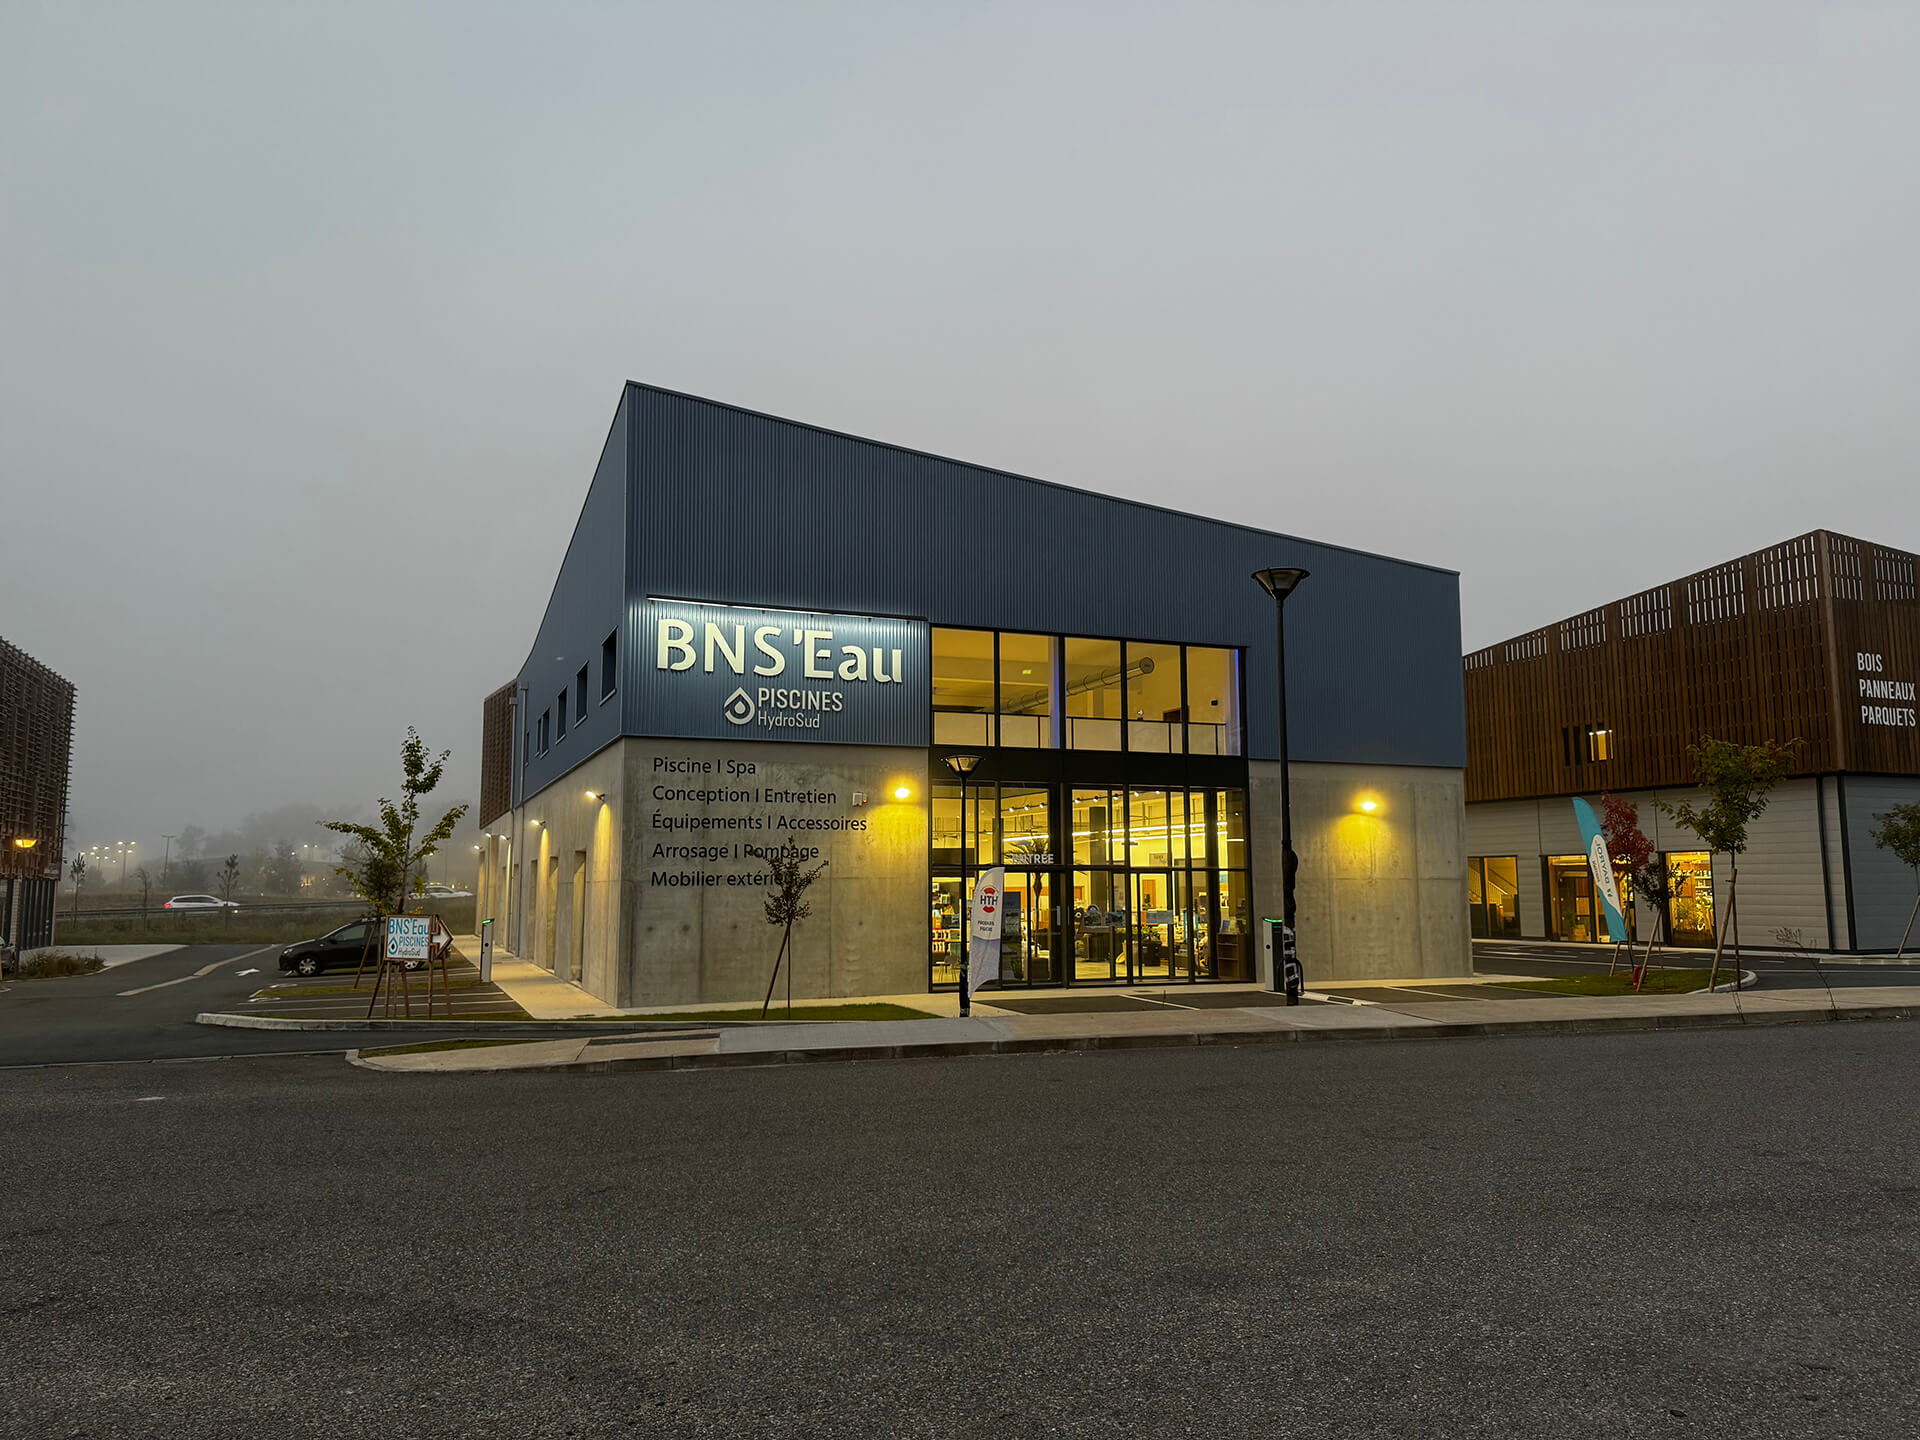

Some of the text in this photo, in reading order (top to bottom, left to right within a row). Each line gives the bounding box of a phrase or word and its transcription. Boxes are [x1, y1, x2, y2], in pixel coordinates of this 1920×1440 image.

[656, 618, 903, 683] BNS'Eau
[1857, 652, 1883, 672] BOIS
[758, 687, 843, 712] PISCINES
[1859, 679, 1916, 701] PANNEAUX
[758, 712, 820, 731] HydroSud
[1861, 705, 1916, 727] PARQUETS
[653, 757, 711, 774] Piscine
[726, 760, 757, 778] Spa
[652, 786, 750, 804] Conception
[765, 789, 837, 804] Entretien
[652, 809, 763, 832] Équipements
[777, 815, 868, 831] Accessoires
[652, 844, 729, 861] Arrosage
[743, 844, 819, 862] Pompage
[651, 870, 800, 887] Mobilier extérie
[980, 895, 998, 905] HTH
[388, 918, 429, 935] BNS'Eau
[400, 936, 429, 947] PISCINES
